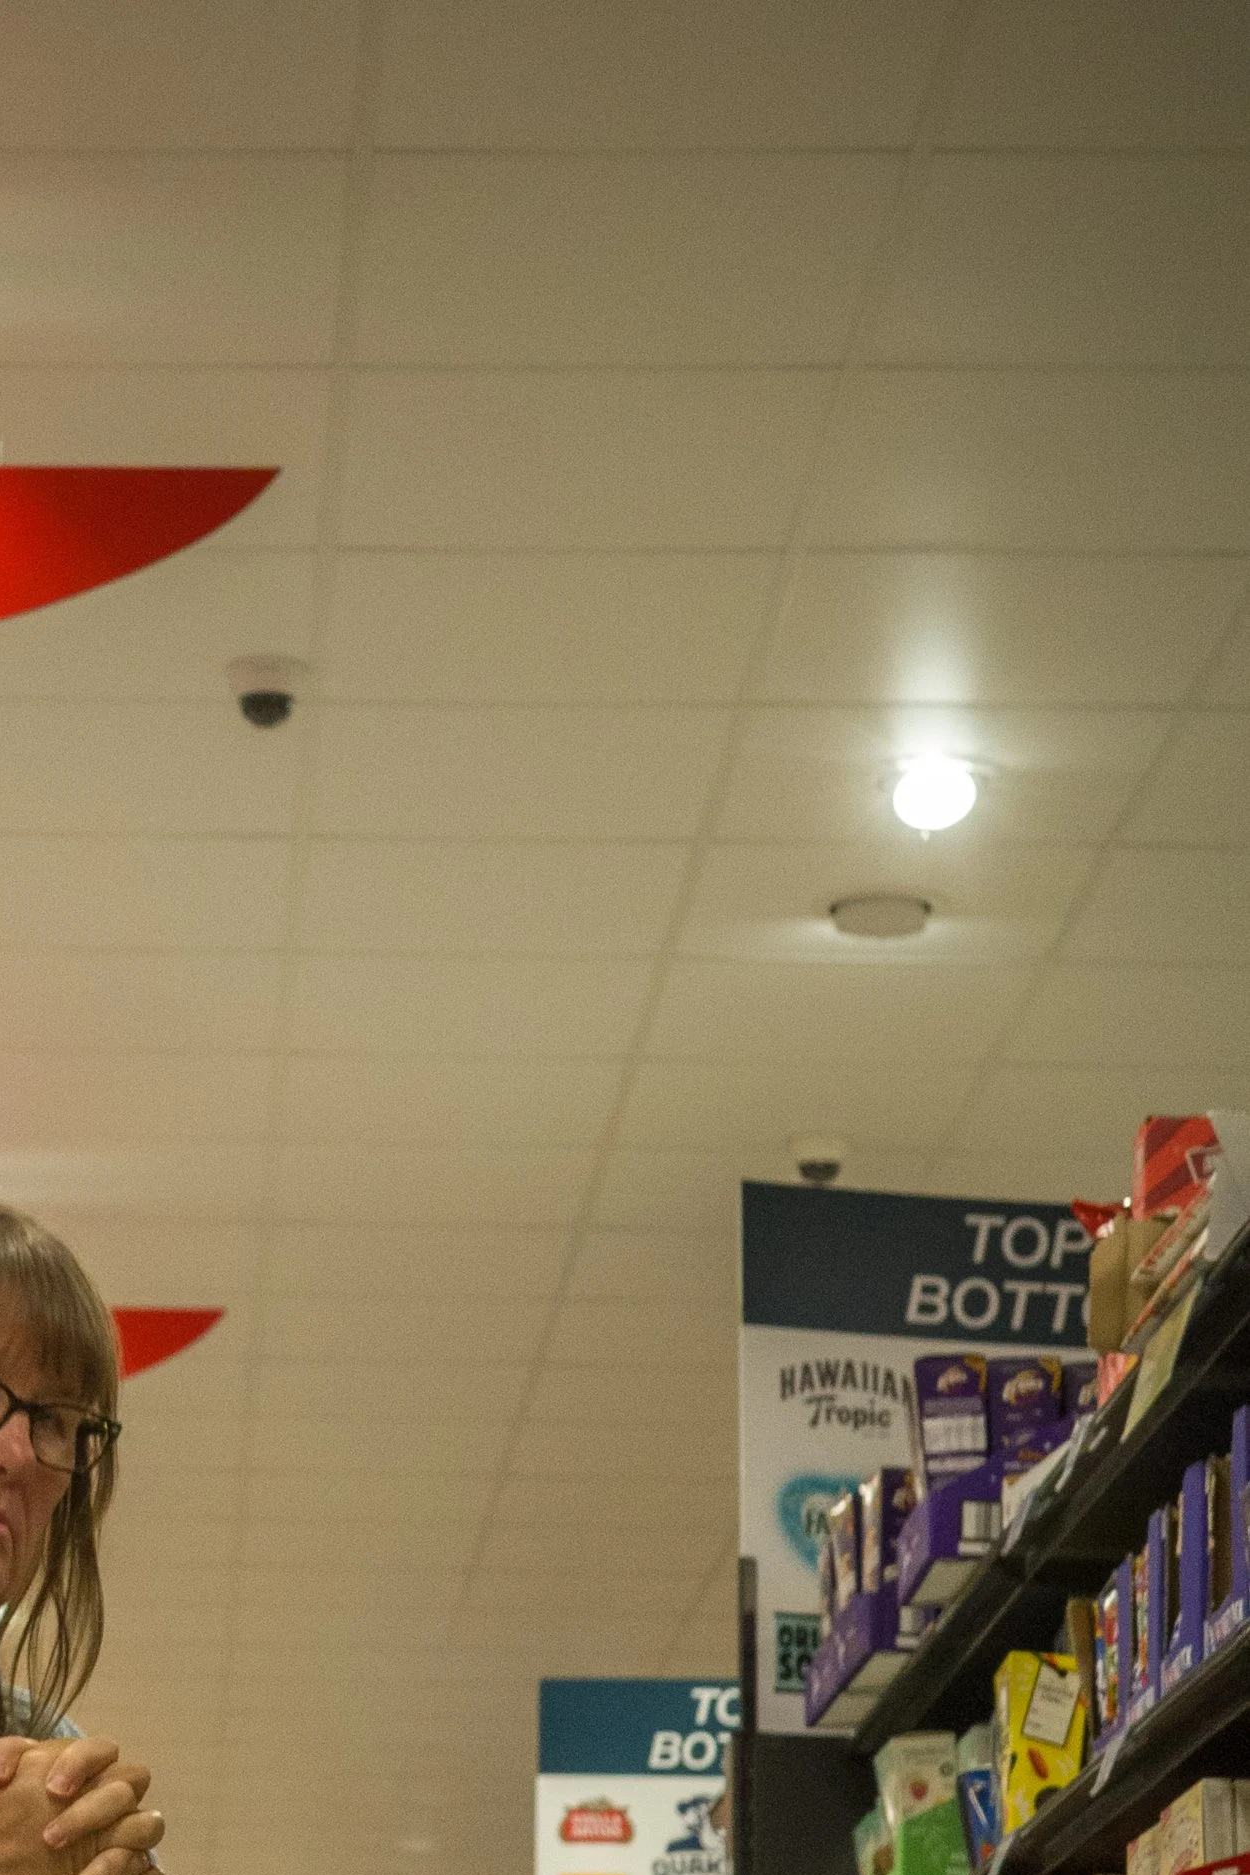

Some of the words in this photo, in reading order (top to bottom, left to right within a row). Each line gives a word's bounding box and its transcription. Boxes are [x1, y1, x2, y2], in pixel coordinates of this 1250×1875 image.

[965, 1213, 1094, 1270] TOP
[904, 1273, 1092, 1334] BOTT
[804, 1394, 893, 1433] Tropic
